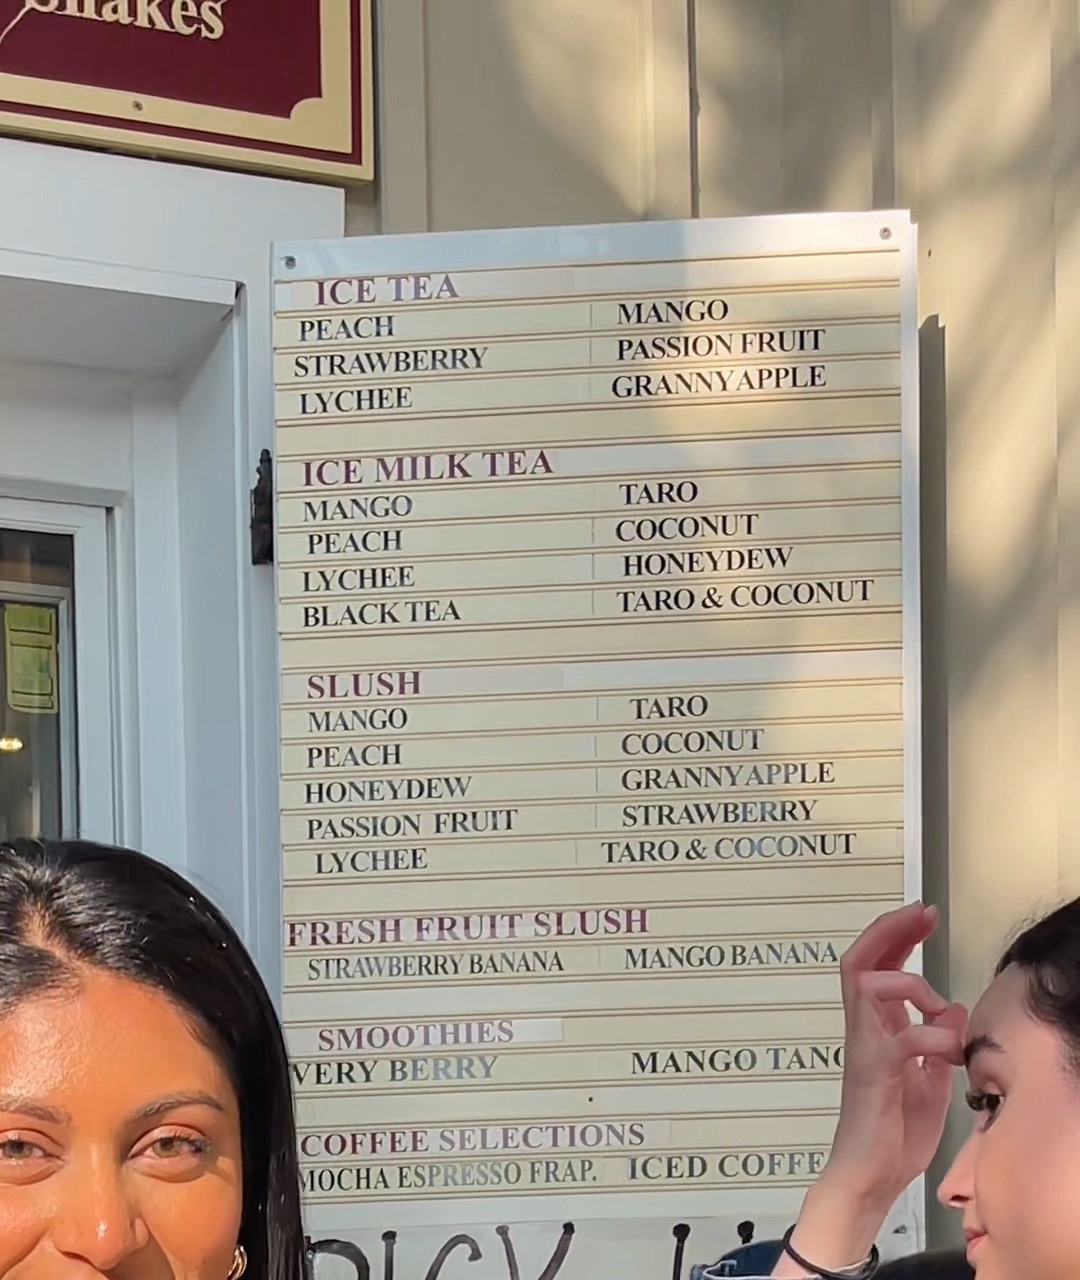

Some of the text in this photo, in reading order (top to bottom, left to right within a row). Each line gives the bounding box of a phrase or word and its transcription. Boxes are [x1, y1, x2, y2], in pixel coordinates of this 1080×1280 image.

[315, 274, 460, 306] ICE TEA
[618, 300, 729, 325] MANGO
[299, 315, 395, 342] PEACH
[616, 329, 826, 361] PASSION FRUIT
[294, 347, 490, 378] STRAWBERRY
[299, 387, 414, 415] LYCHEE
[301, 451, 555, 487] ICE MILK TEA
[620, 481, 699, 506] TARO
[302, 496, 414, 522] MANGO
[307, 529, 403, 555] PEACH
[615, 514, 760, 544] COCONUT
[623, 547, 795, 577] HONEYDEW
[302, 566, 416, 592] LYCHEE
[616, 580, 875, 613] TARO & COCONUT
[303, 600, 461, 627] BLACK TEA
[306, 671, 421, 699] SLUSH
[307, 708, 408, 732] MANGO
[630, 695, 708, 720] TARO
[306, 743, 402, 769] PEACH
[621, 729, 766, 756] COCONUT
[305, 776, 473, 805] HONEYDEW
[307, 809, 519, 841] PASSION FRUIT
[622, 799, 819, 828] STRAWBERRY
[315, 848, 428, 874] LYCHEE
[601, 833, 858, 863] TARO & COCONUT
[286, 908, 650, 948] FRESH FRUIT SLUSH
[307, 951, 565, 981] STRAWBERRY BANANA
[625, 942, 839, 970] MANGO BANANA
[318, 1019, 514, 1052] SMOOTHIES
[292, 1055, 499, 1087] VERY BERRY
[631, 1048, 758, 1075] MANGO
[300, 1122, 646, 1158] COFFEE SELECTIONS
[398, 1161, 521, 1190] ESPRESSO
[530, 1159, 598, 1184] FRAP.
[628, 1155, 708, 1180] ICED
